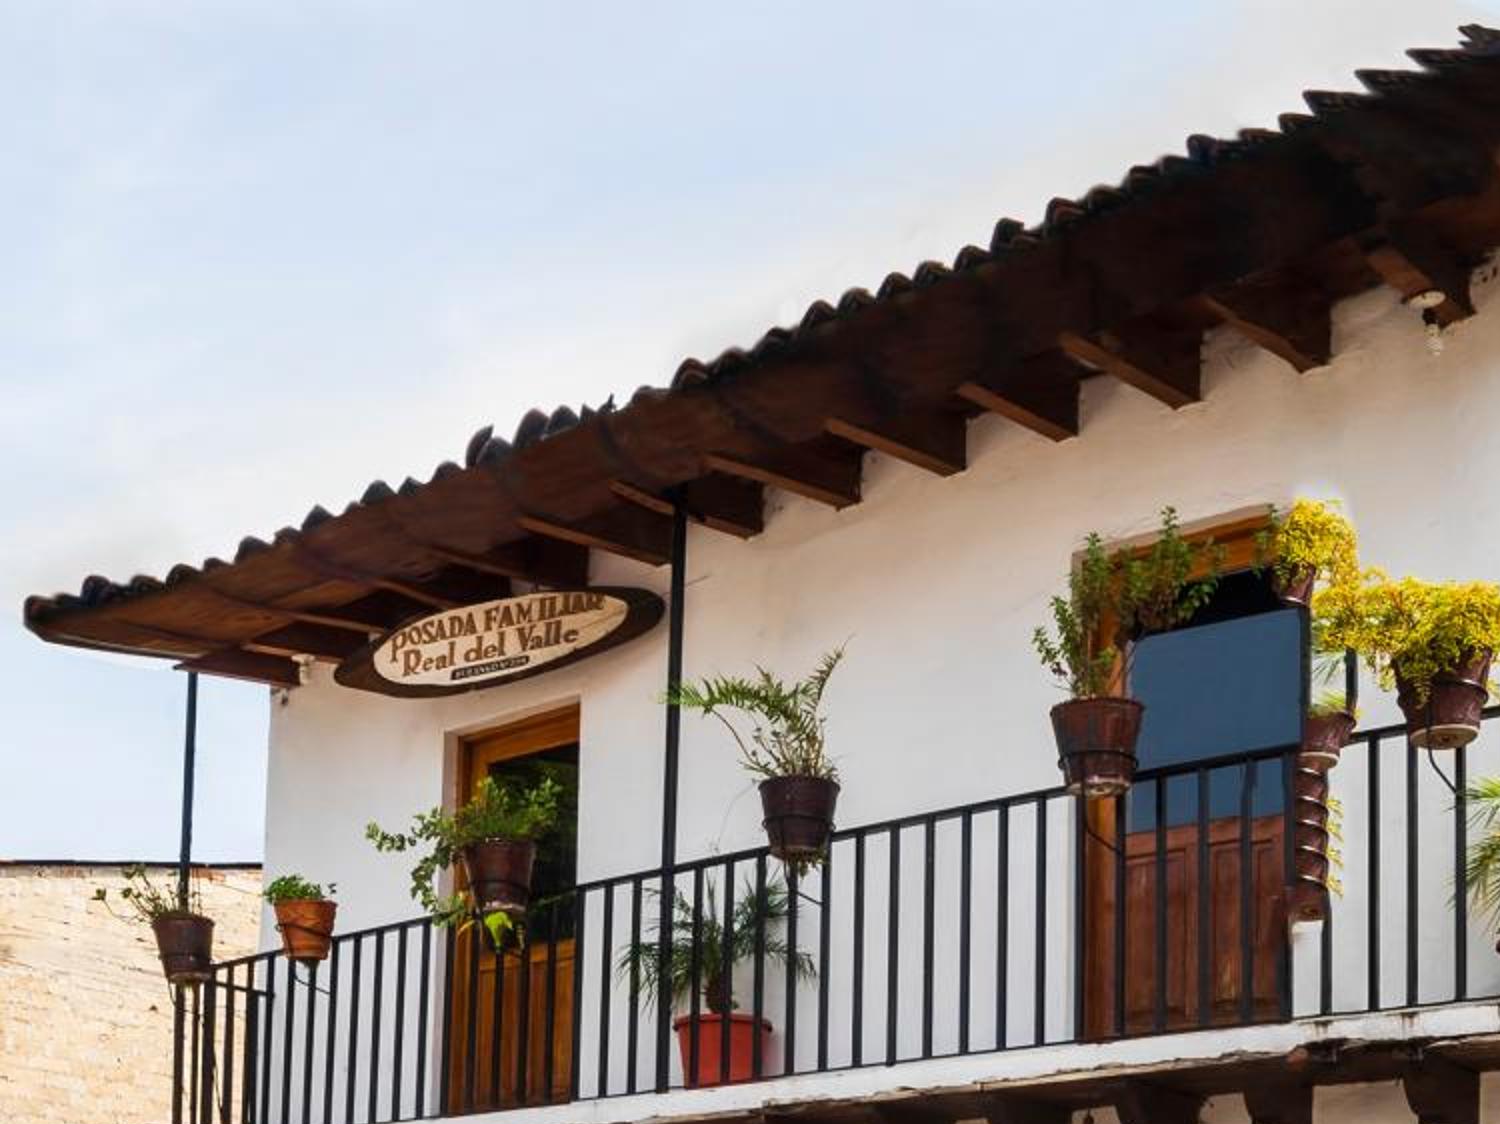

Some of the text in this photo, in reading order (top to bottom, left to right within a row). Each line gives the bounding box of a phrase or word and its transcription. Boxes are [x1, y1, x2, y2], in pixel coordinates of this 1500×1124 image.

[390, 613, 476, 663] POSADA
[402, 641, 455, 677] Real
[464, 631, 506, 662] del
[516, 620, 580, 651] Valle
